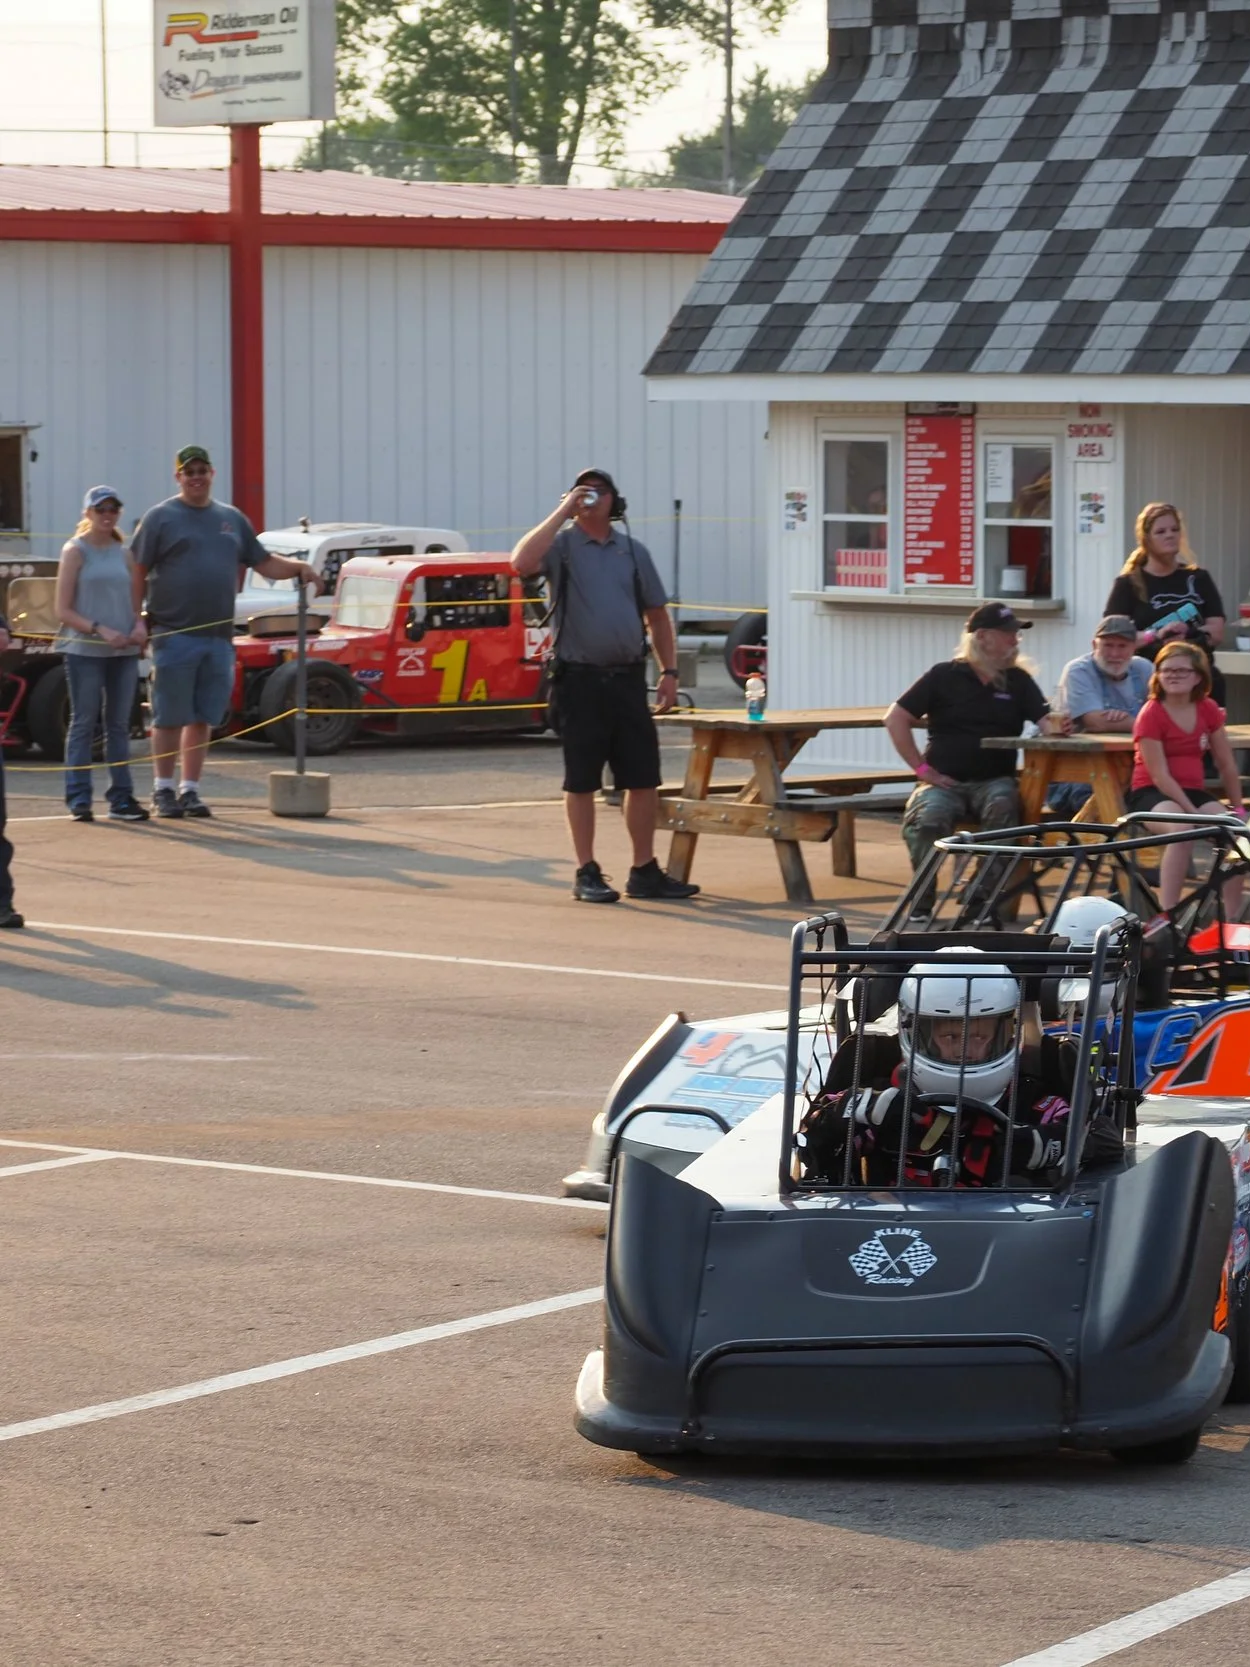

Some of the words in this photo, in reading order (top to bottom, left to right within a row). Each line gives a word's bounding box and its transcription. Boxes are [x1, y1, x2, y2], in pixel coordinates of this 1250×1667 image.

[280, 7, 298, 23] Oil
[1068, 423, 1112, 438] SMOKING
[1077, 443, 1103, 457] AREA
[874, 1228, 922, 1238] KLINE
[864, 1274, 915, 1287] Racing
